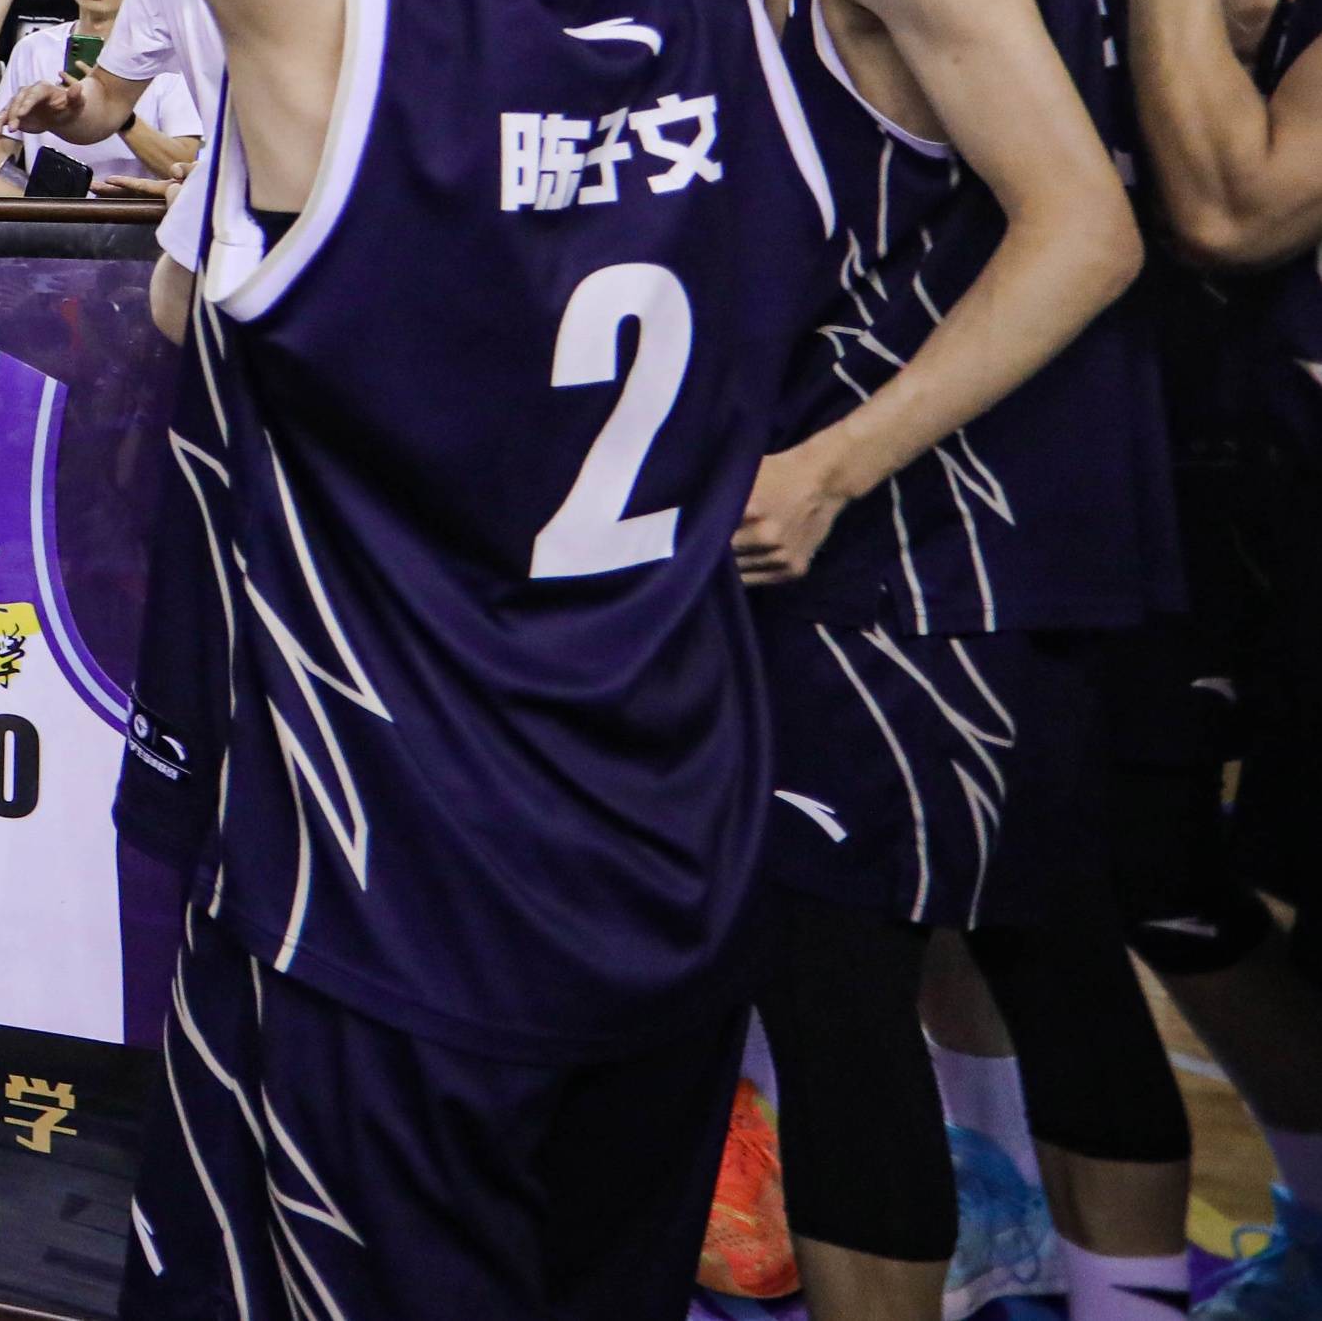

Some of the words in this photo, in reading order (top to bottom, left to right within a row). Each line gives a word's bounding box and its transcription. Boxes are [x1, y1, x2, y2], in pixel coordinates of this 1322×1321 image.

[500, 93, 724, 213] 陈子文
[529, 262, 695, 580] 2
